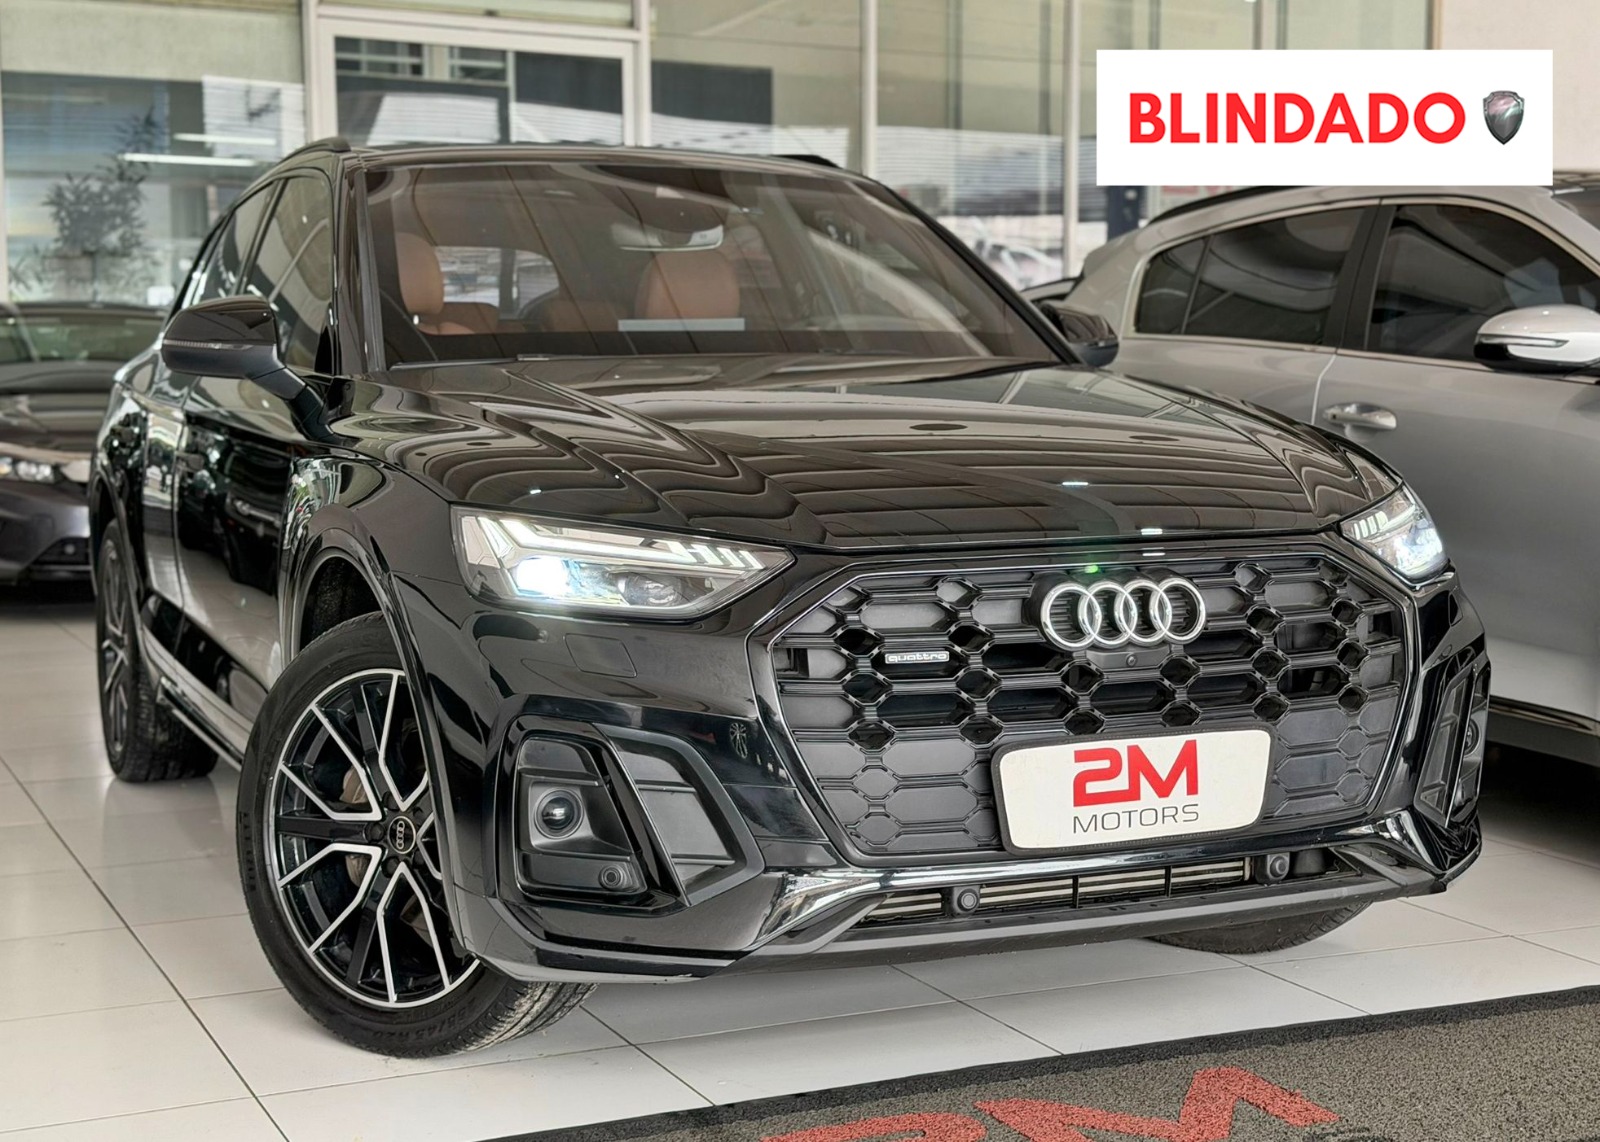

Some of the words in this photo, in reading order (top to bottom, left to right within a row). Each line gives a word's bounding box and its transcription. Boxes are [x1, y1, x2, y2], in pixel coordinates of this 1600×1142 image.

[887, 652, 948, 663] quattro
[1073, 739, 1199, 808] 2M
[1073, 803, 1199, 834] MOTORS
